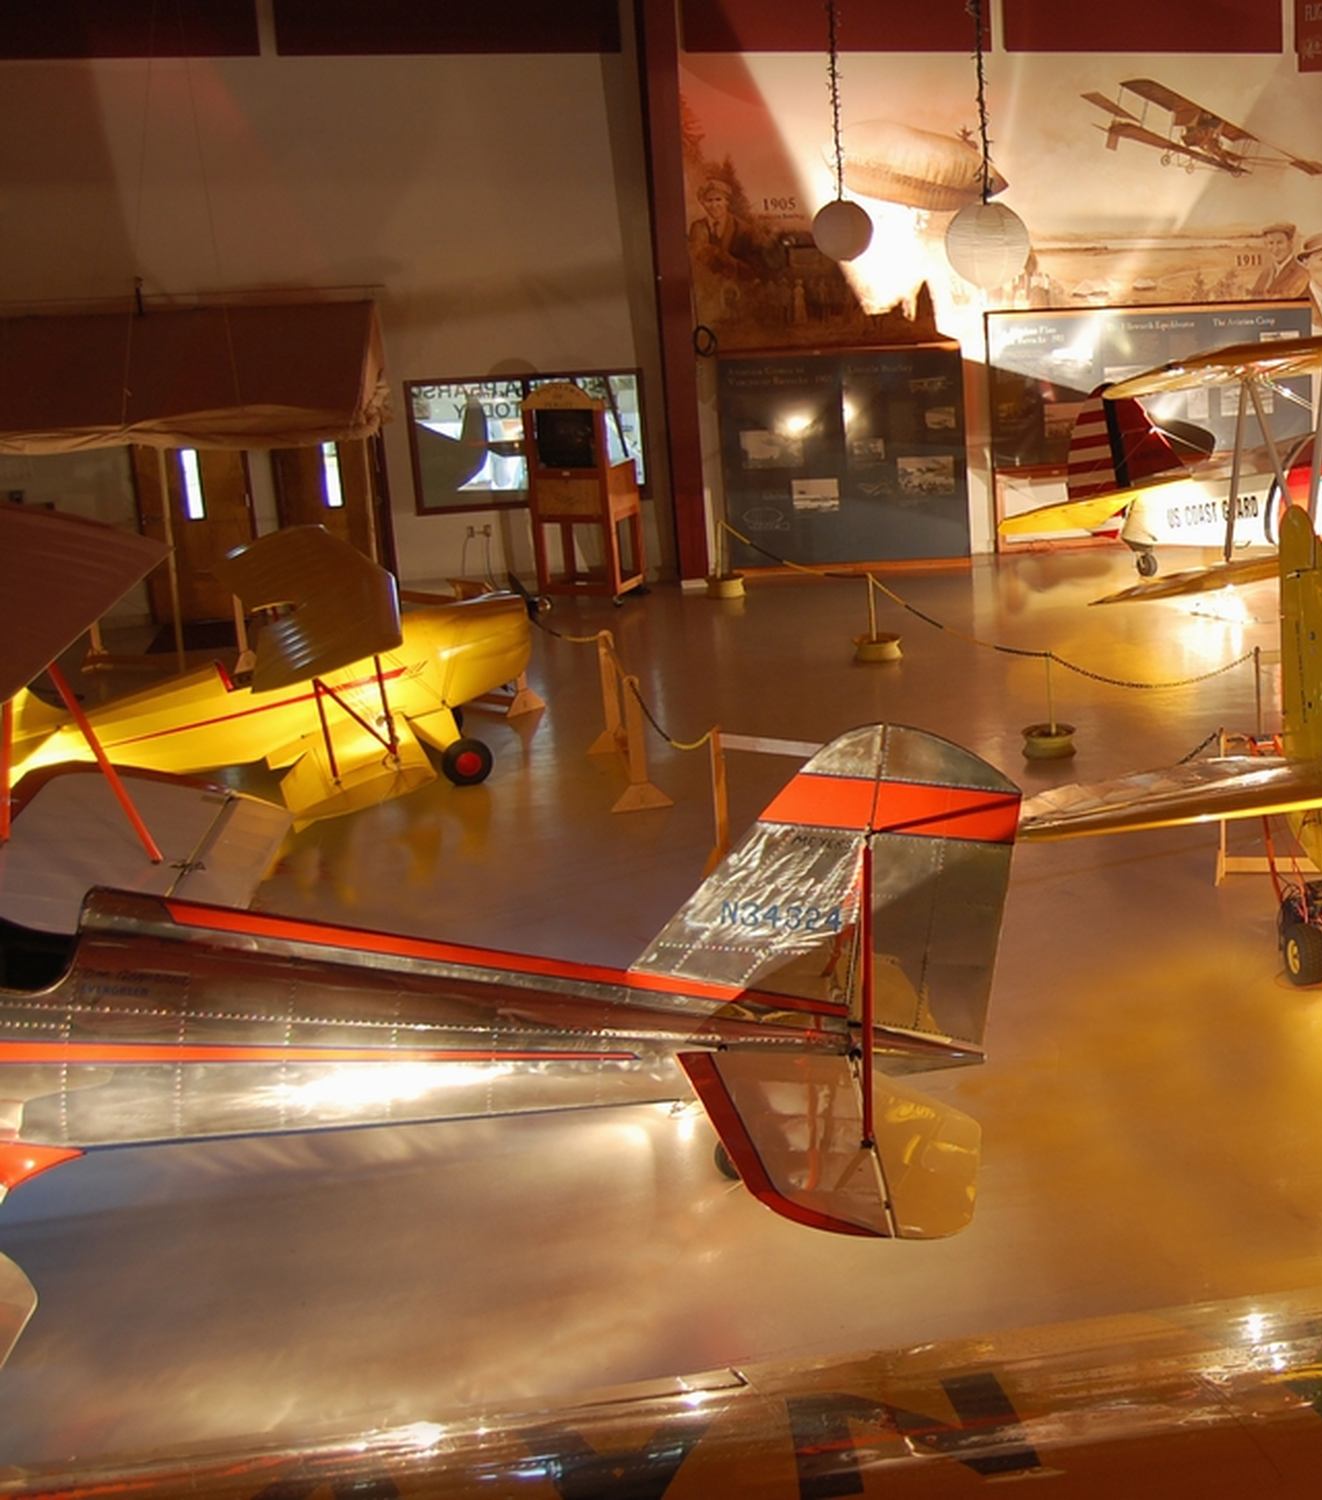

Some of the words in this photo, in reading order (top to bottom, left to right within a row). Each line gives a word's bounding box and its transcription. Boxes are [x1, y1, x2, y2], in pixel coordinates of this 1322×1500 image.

[762, 196, 798, 211] 1905
[1236, 254, 1262, 267] 1911
[1167, 507, 1182, 528] US
[1185, 501, 1218, 526] COAST
[1222, 495, 1259, 522] GARD
[719, 898, 843, 932] N34324
